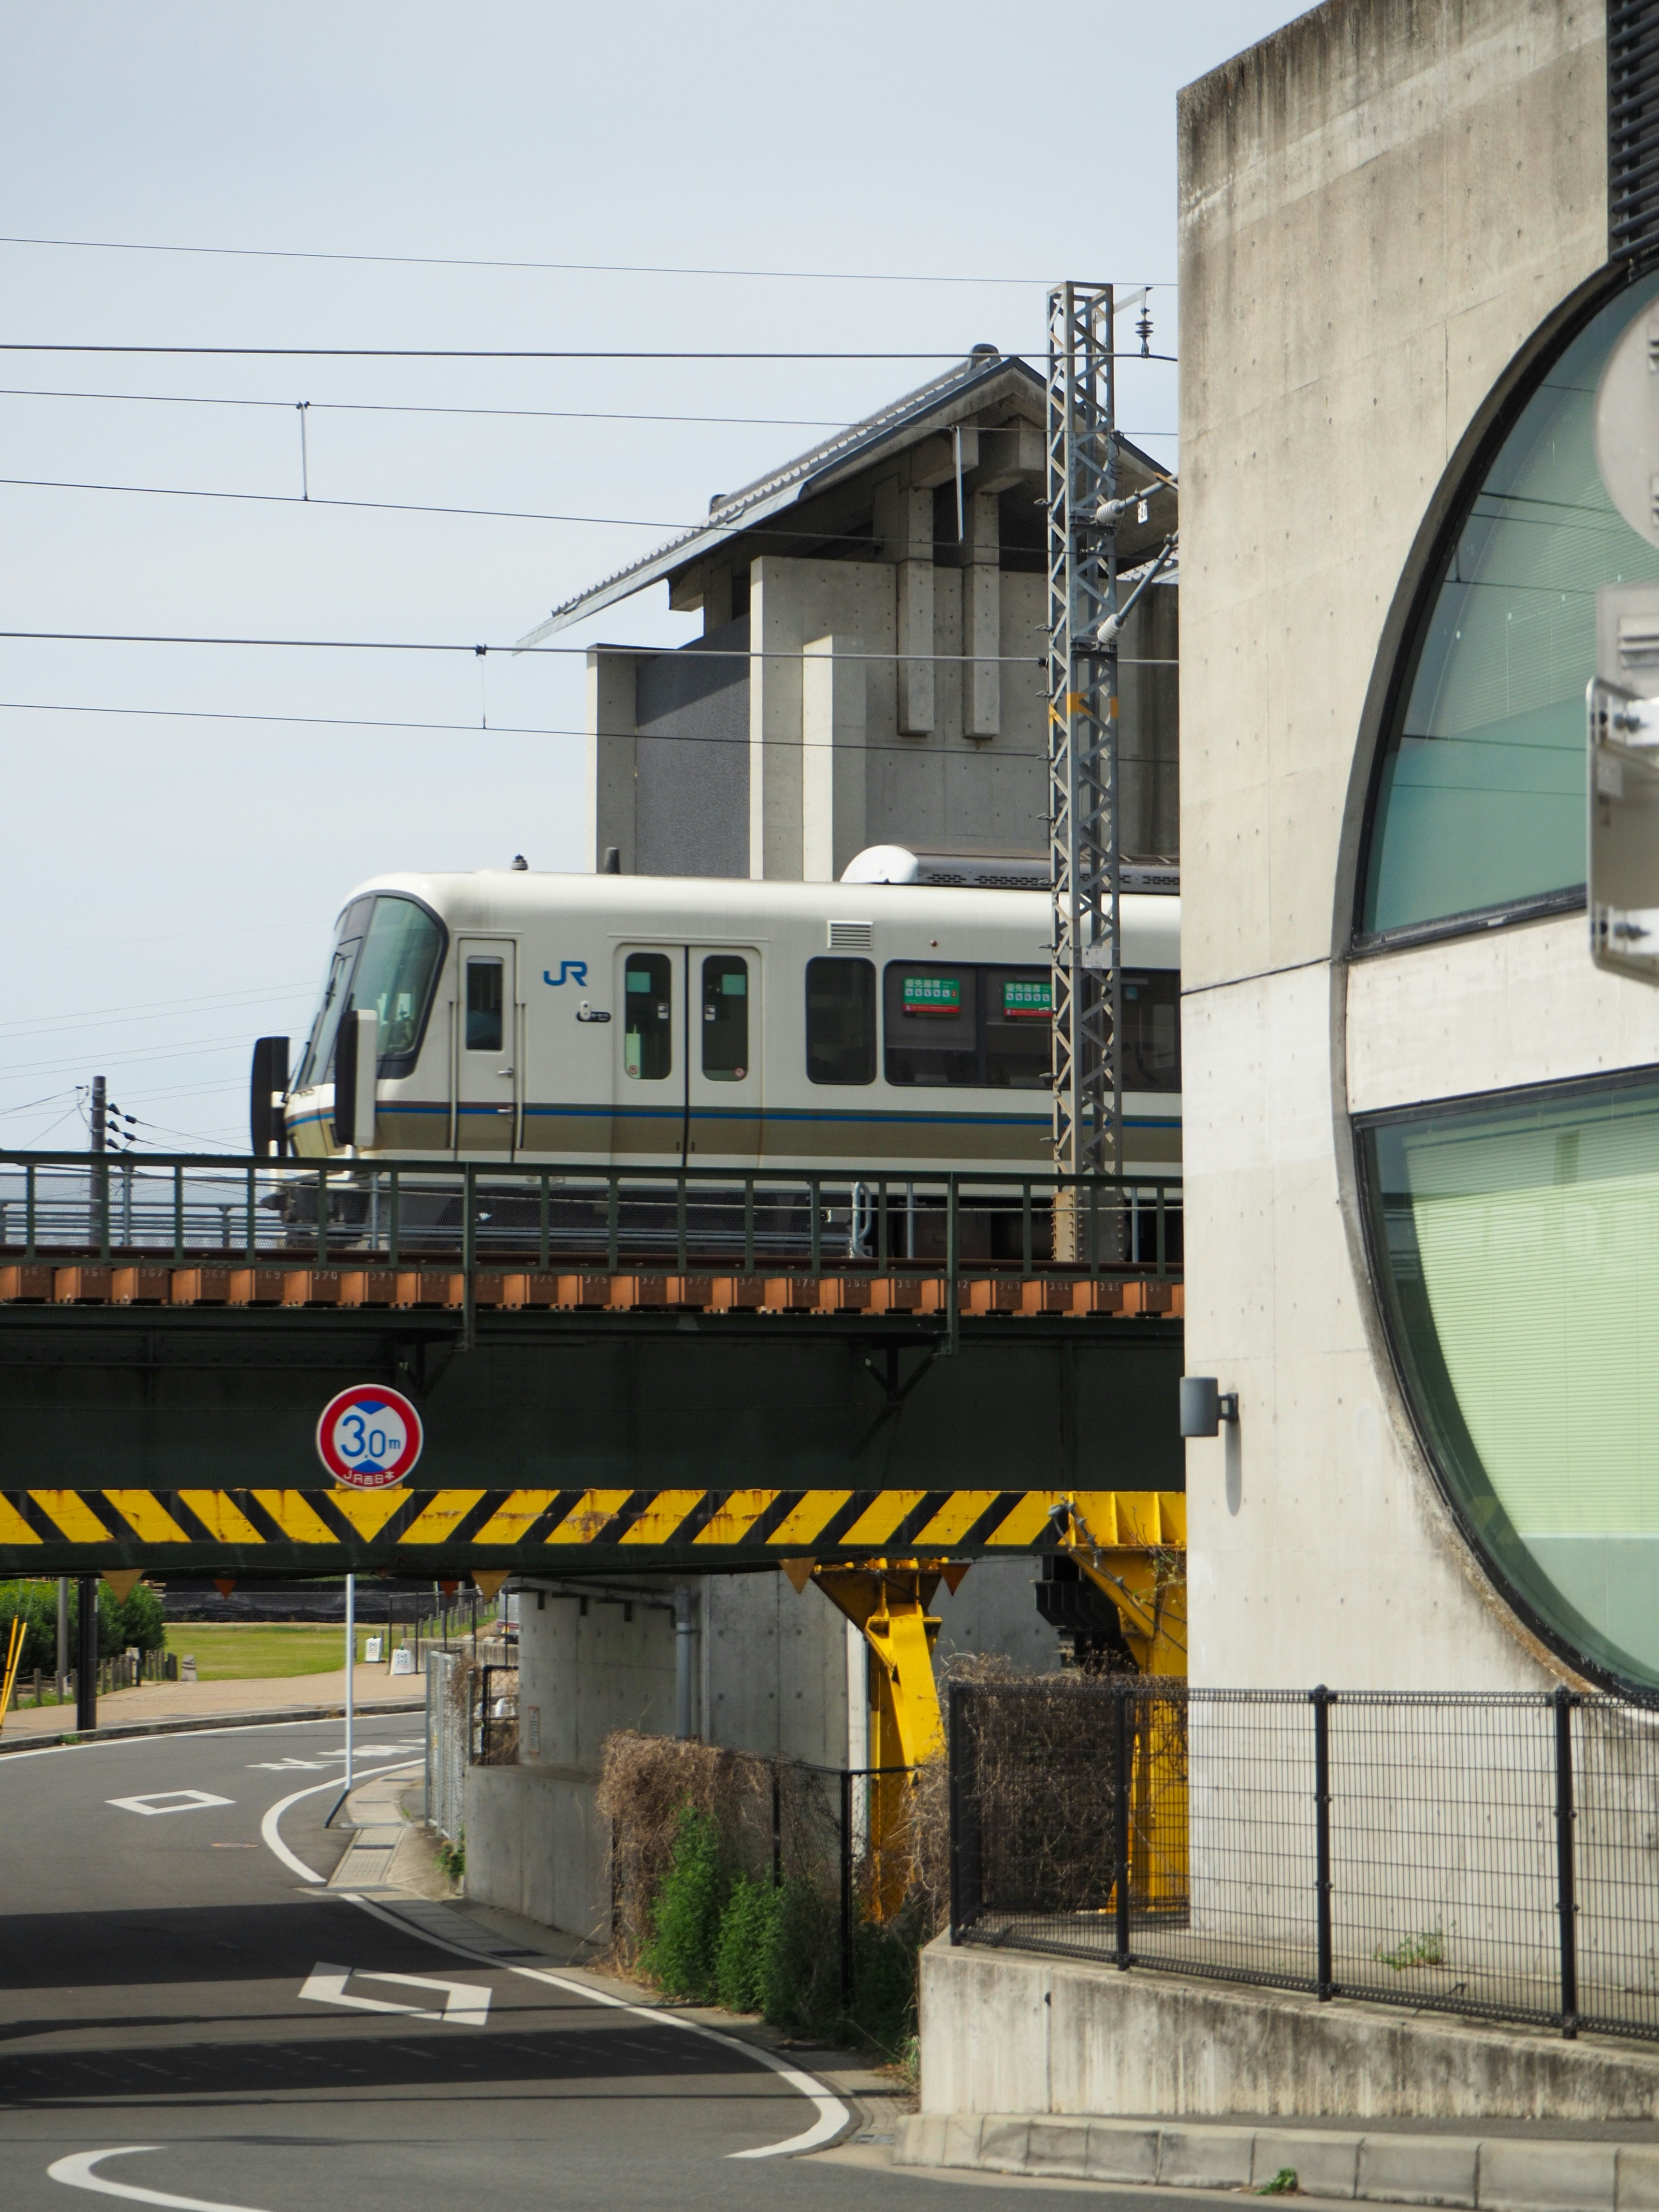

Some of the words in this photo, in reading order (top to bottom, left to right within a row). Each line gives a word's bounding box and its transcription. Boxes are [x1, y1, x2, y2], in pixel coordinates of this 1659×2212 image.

[544, 960, 588, 986] JR
[140, 1268, 164, 1277] 367
[258, 1270, 280, 1279] 369
[314, 1271, 337, 1280] 370
[371, 1272, 393, 1281] 371
[424, 1273, 445, 1282] 372
[796, 1278, 815, 1287] 379
[1100, 1282, 1120, 1291] 385
[344, 1470, 394, 1485] JR西日本
